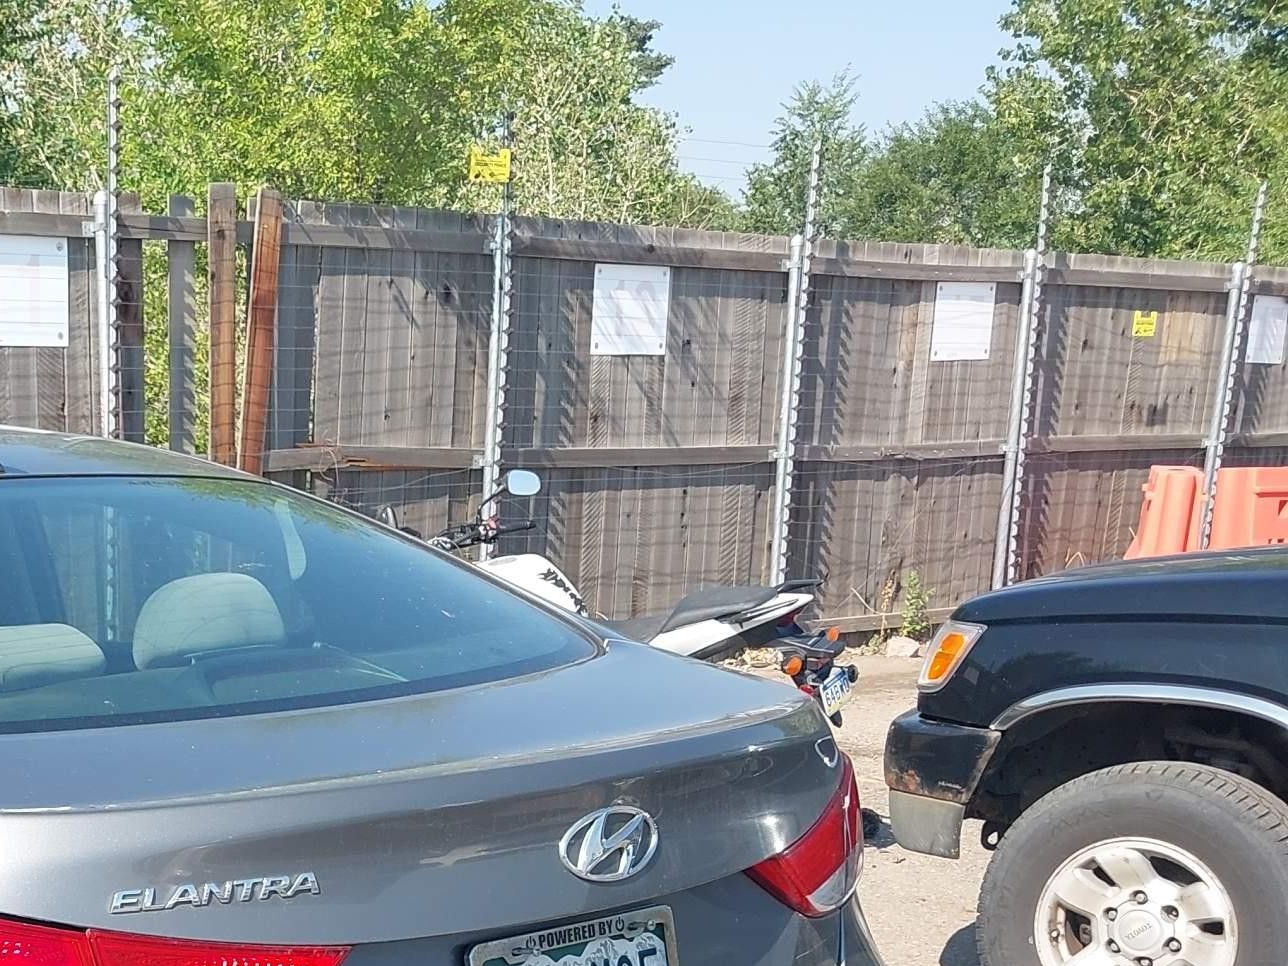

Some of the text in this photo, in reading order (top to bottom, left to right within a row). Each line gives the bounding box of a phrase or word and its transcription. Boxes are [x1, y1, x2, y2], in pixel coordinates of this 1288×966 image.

[109, 871, 320, 914] ELANTRA
[538, 919, 614, 948] POWERED BY
